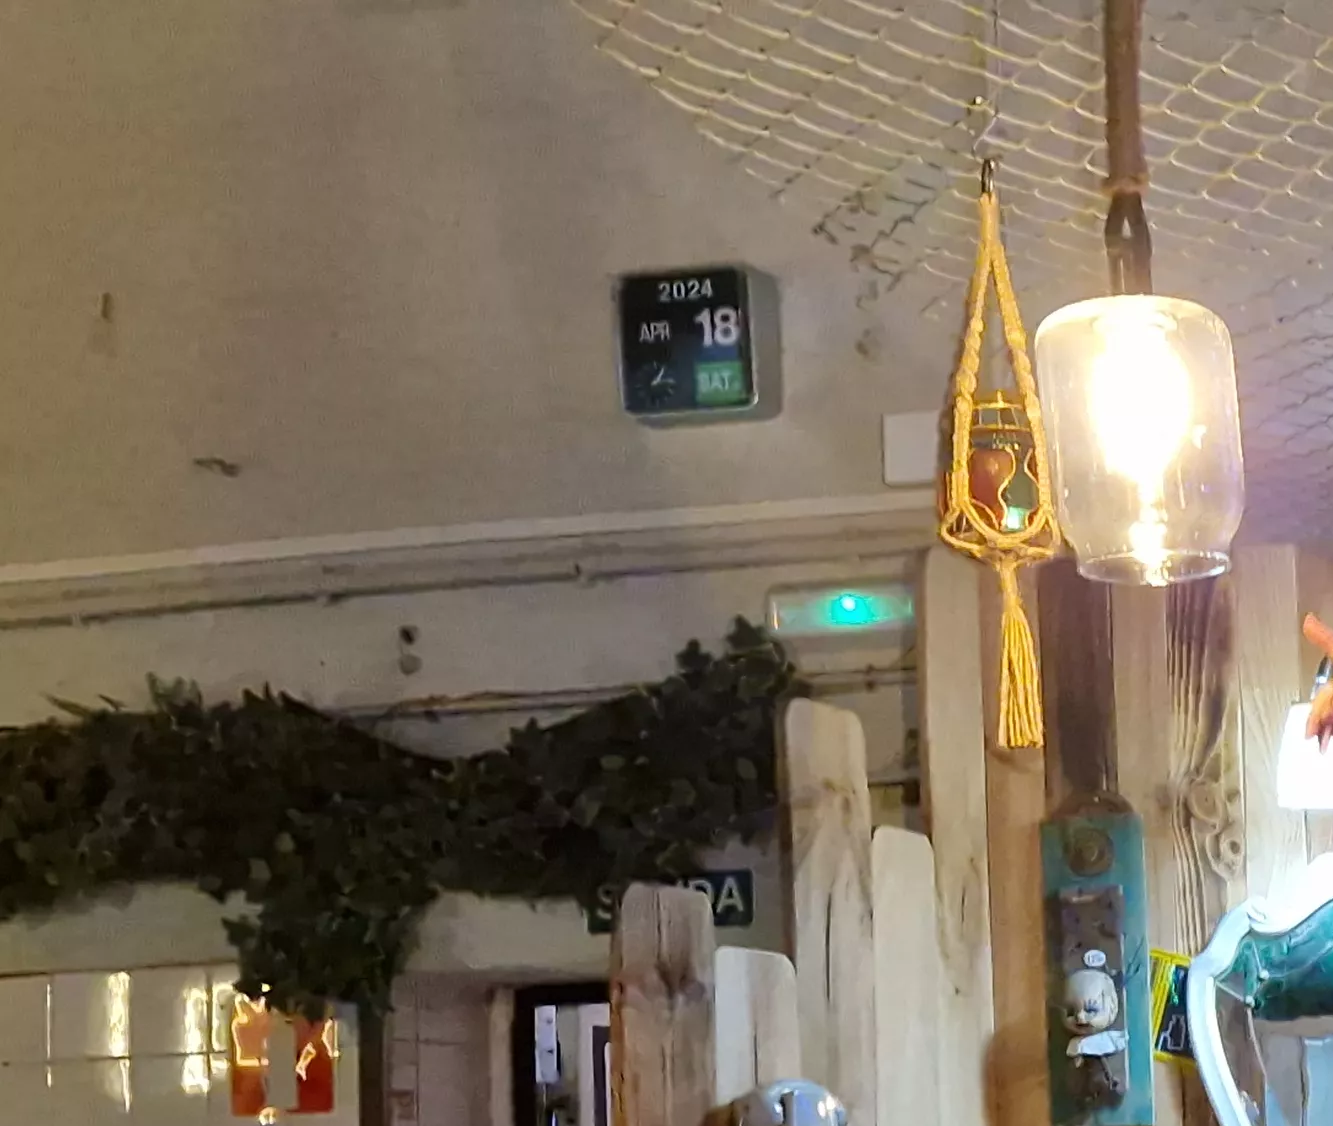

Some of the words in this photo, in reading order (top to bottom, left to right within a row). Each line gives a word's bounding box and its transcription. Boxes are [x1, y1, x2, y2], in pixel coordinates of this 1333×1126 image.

[658, 278, 713, 302] 2024
[639, 320, 671, 342] APR
[694, 306, 740, 347] 18
